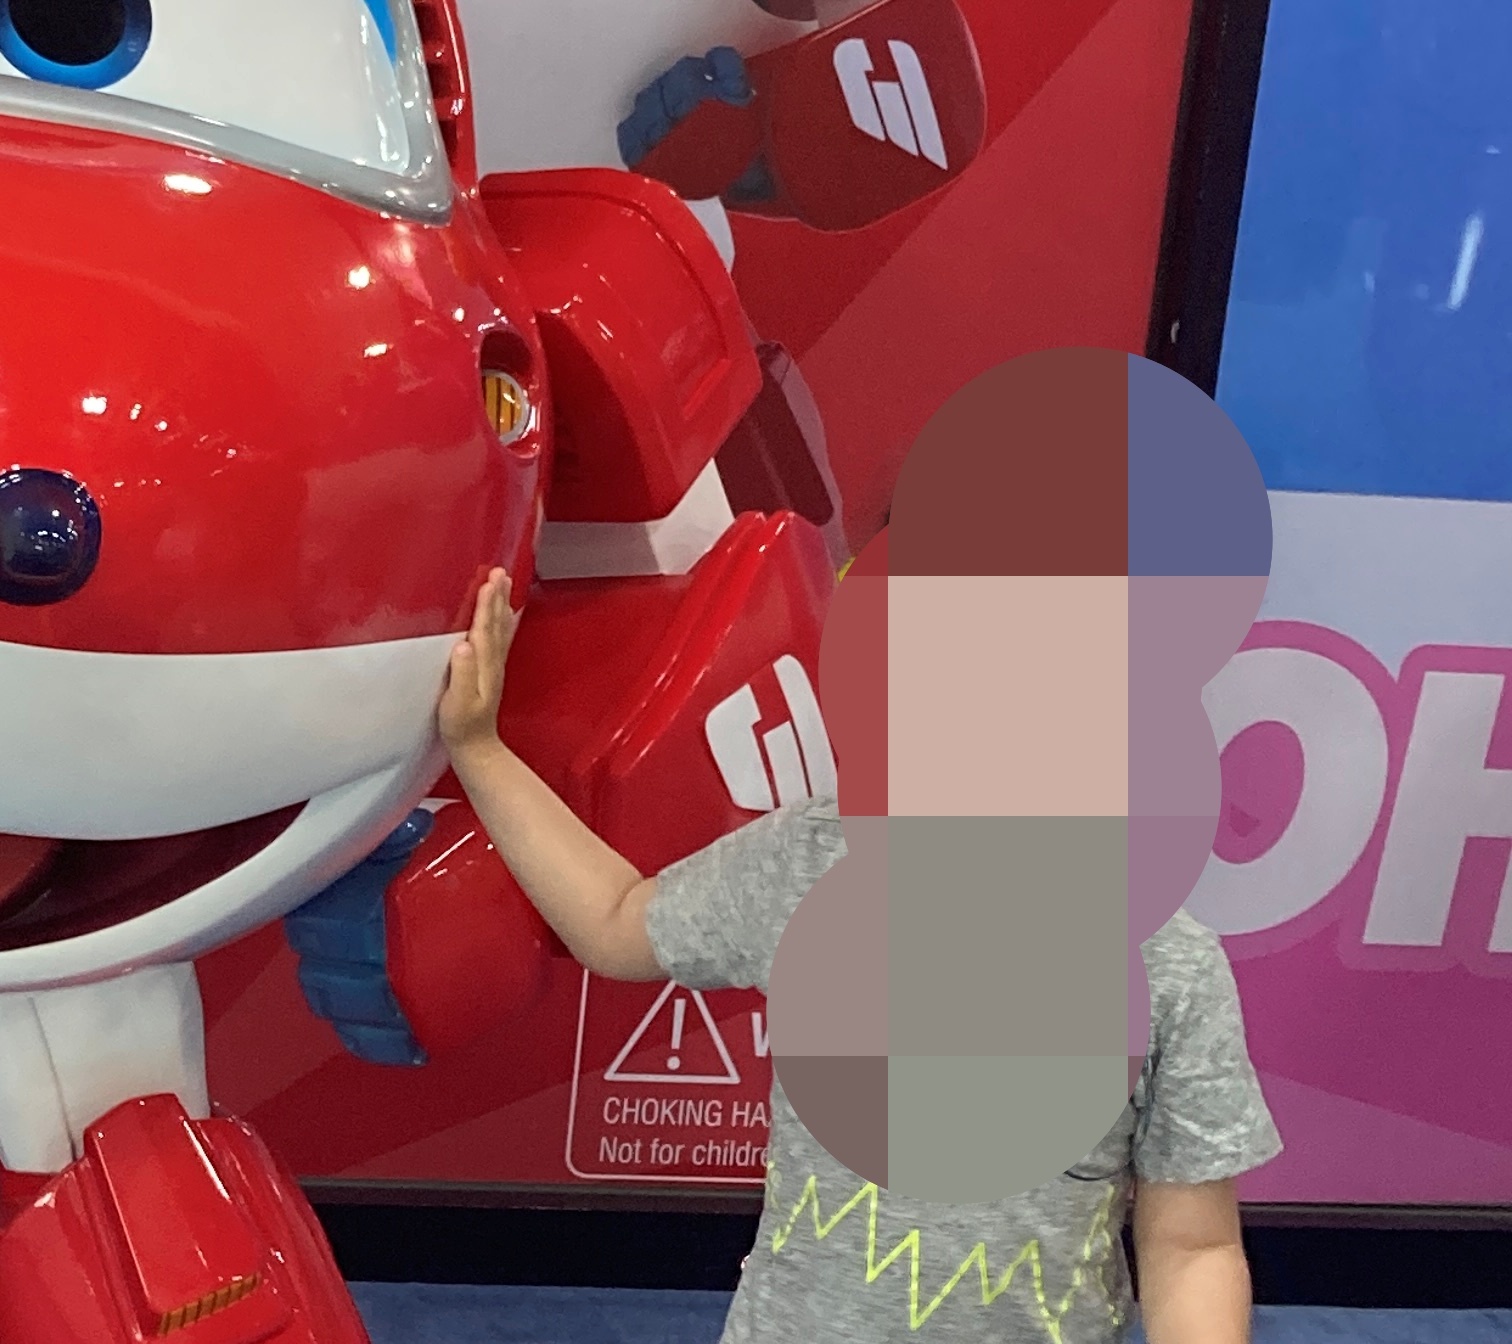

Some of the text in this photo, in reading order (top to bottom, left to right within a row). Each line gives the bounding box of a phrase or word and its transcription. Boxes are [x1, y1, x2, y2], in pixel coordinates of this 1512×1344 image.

[602, 1096, 772, 1128] CHOKING HA
[599, 1136, 642, 1164] Not
[650, 1138, 685, 1165] for
